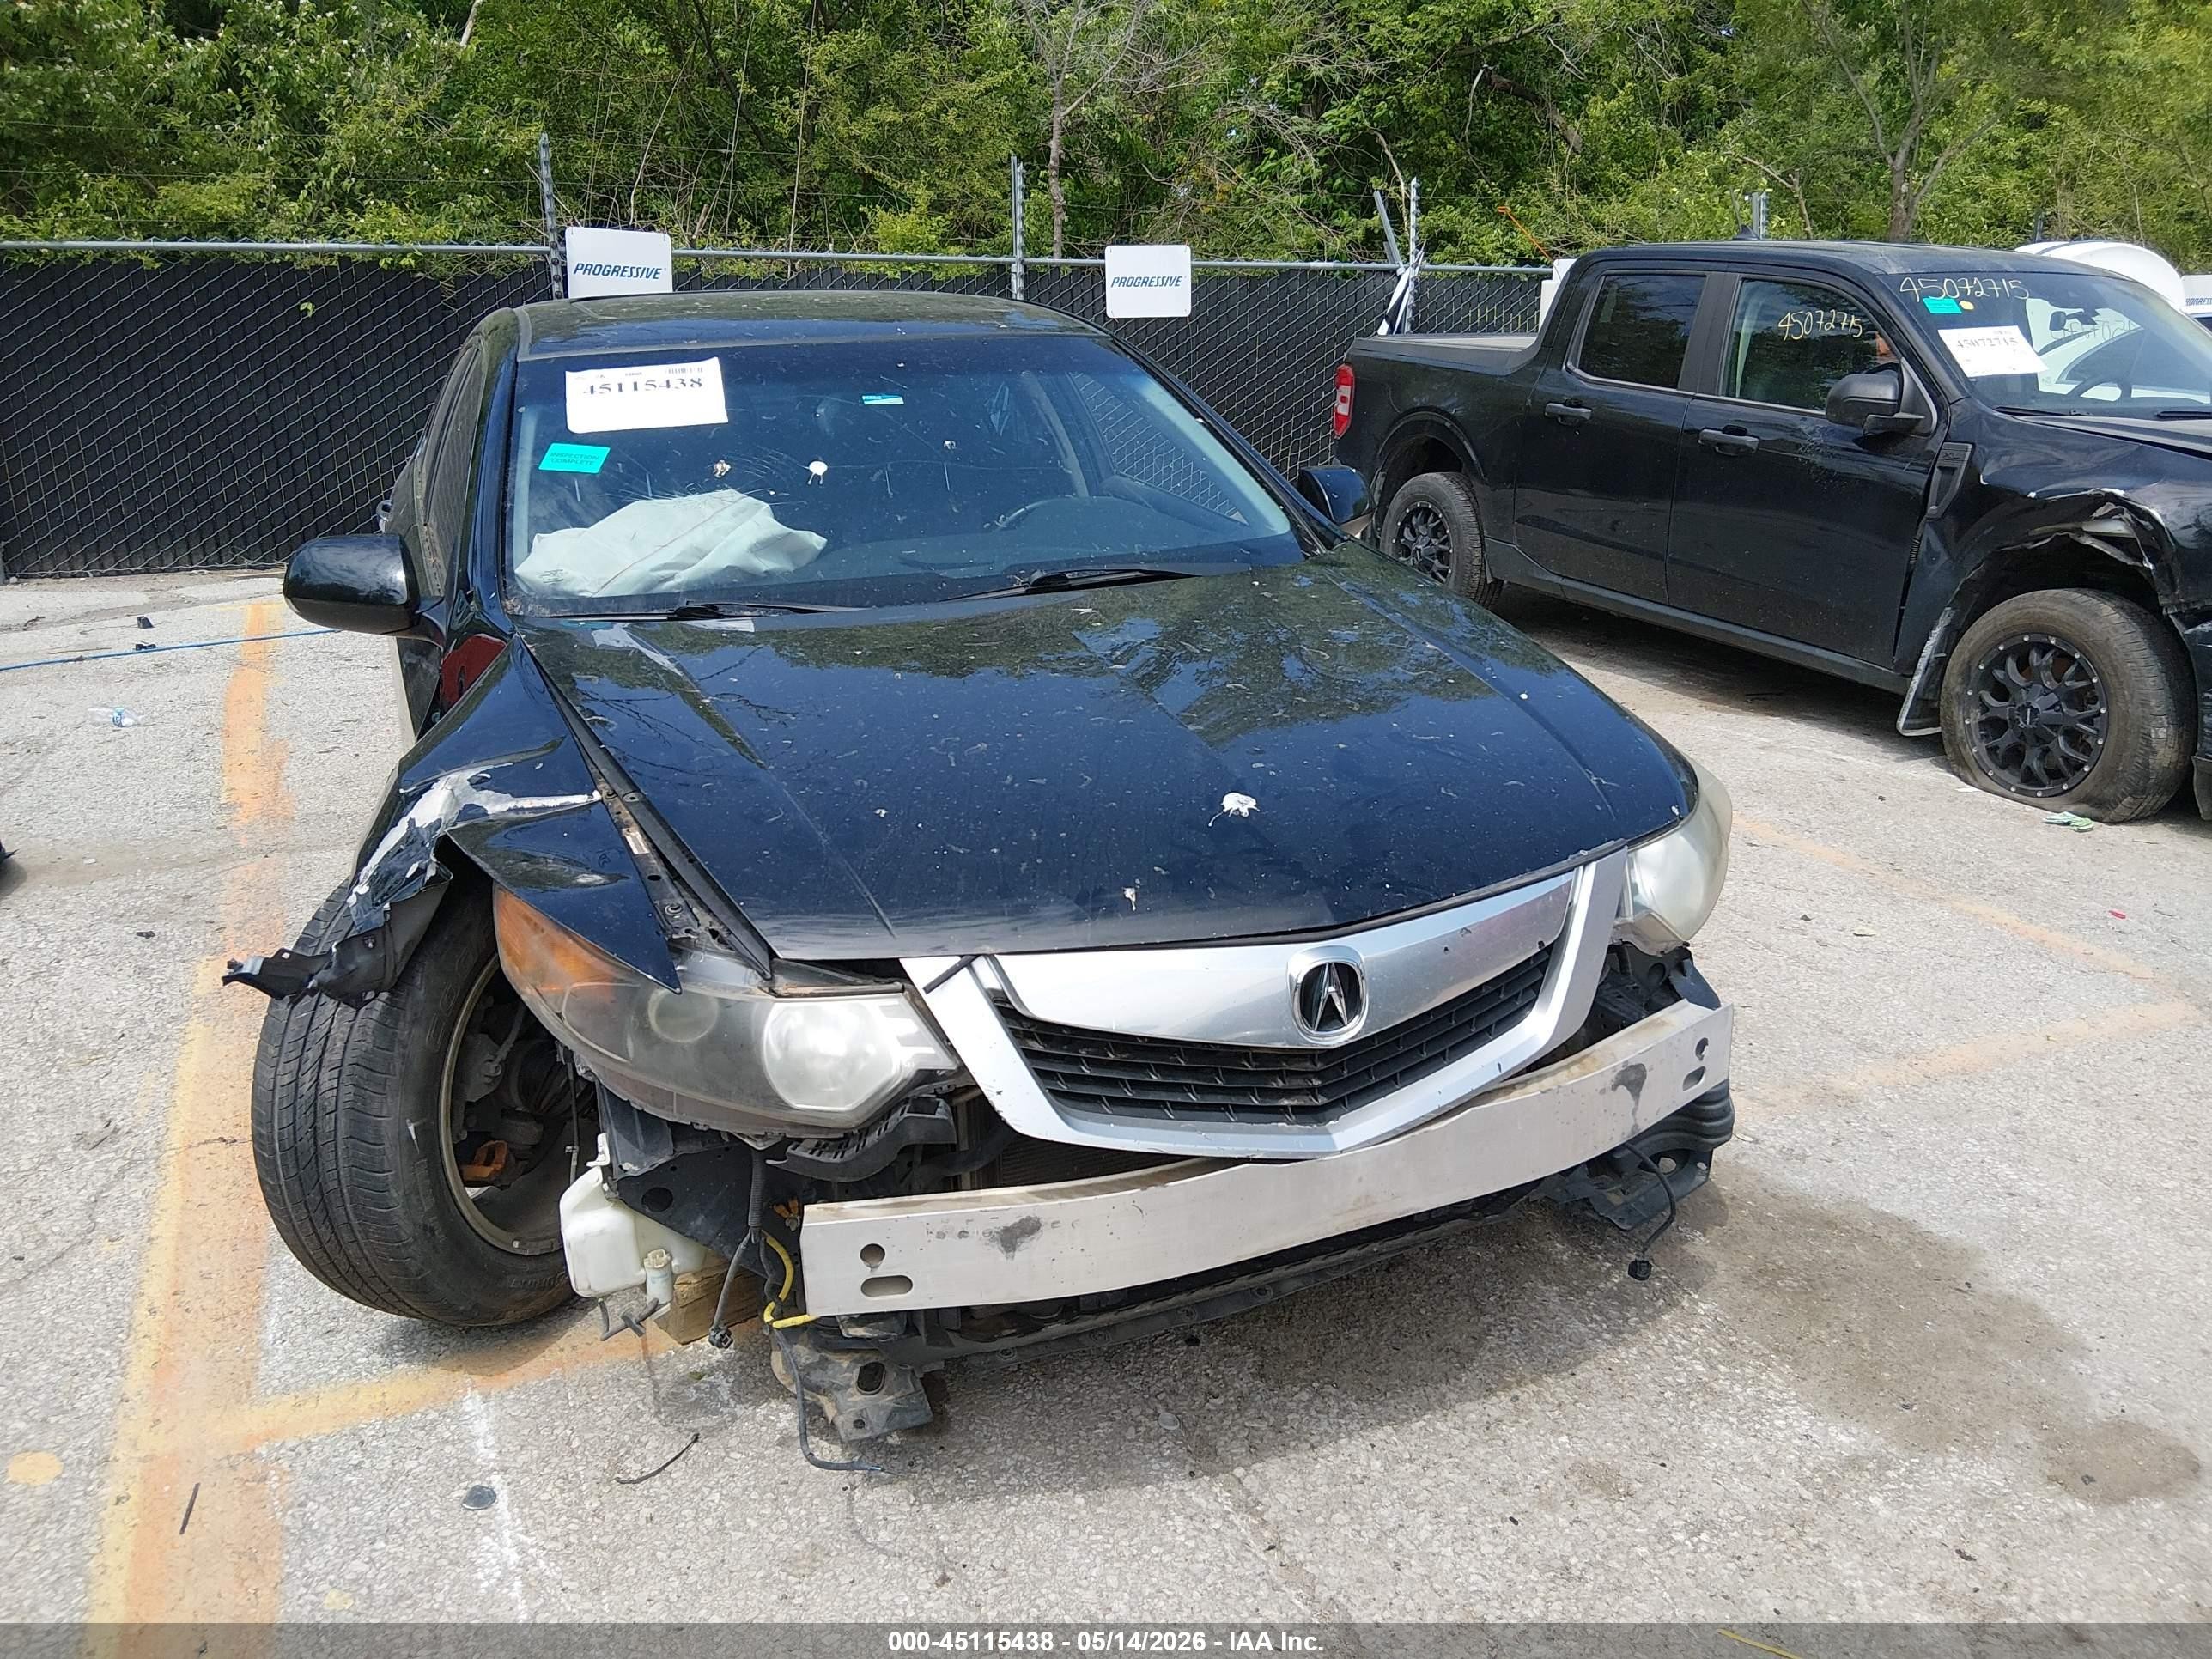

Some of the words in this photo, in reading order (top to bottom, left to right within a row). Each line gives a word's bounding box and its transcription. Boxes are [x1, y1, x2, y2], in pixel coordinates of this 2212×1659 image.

[573, 263, 663, 280] PROGRESSIVE
[1110, 276, 1182, 288] PROGRESSIVE
[1899, 276, 2030, 302] 45072715
[1778, 309, 1863, 341] 45072715
[583, 378, 703, 395] 45115438
